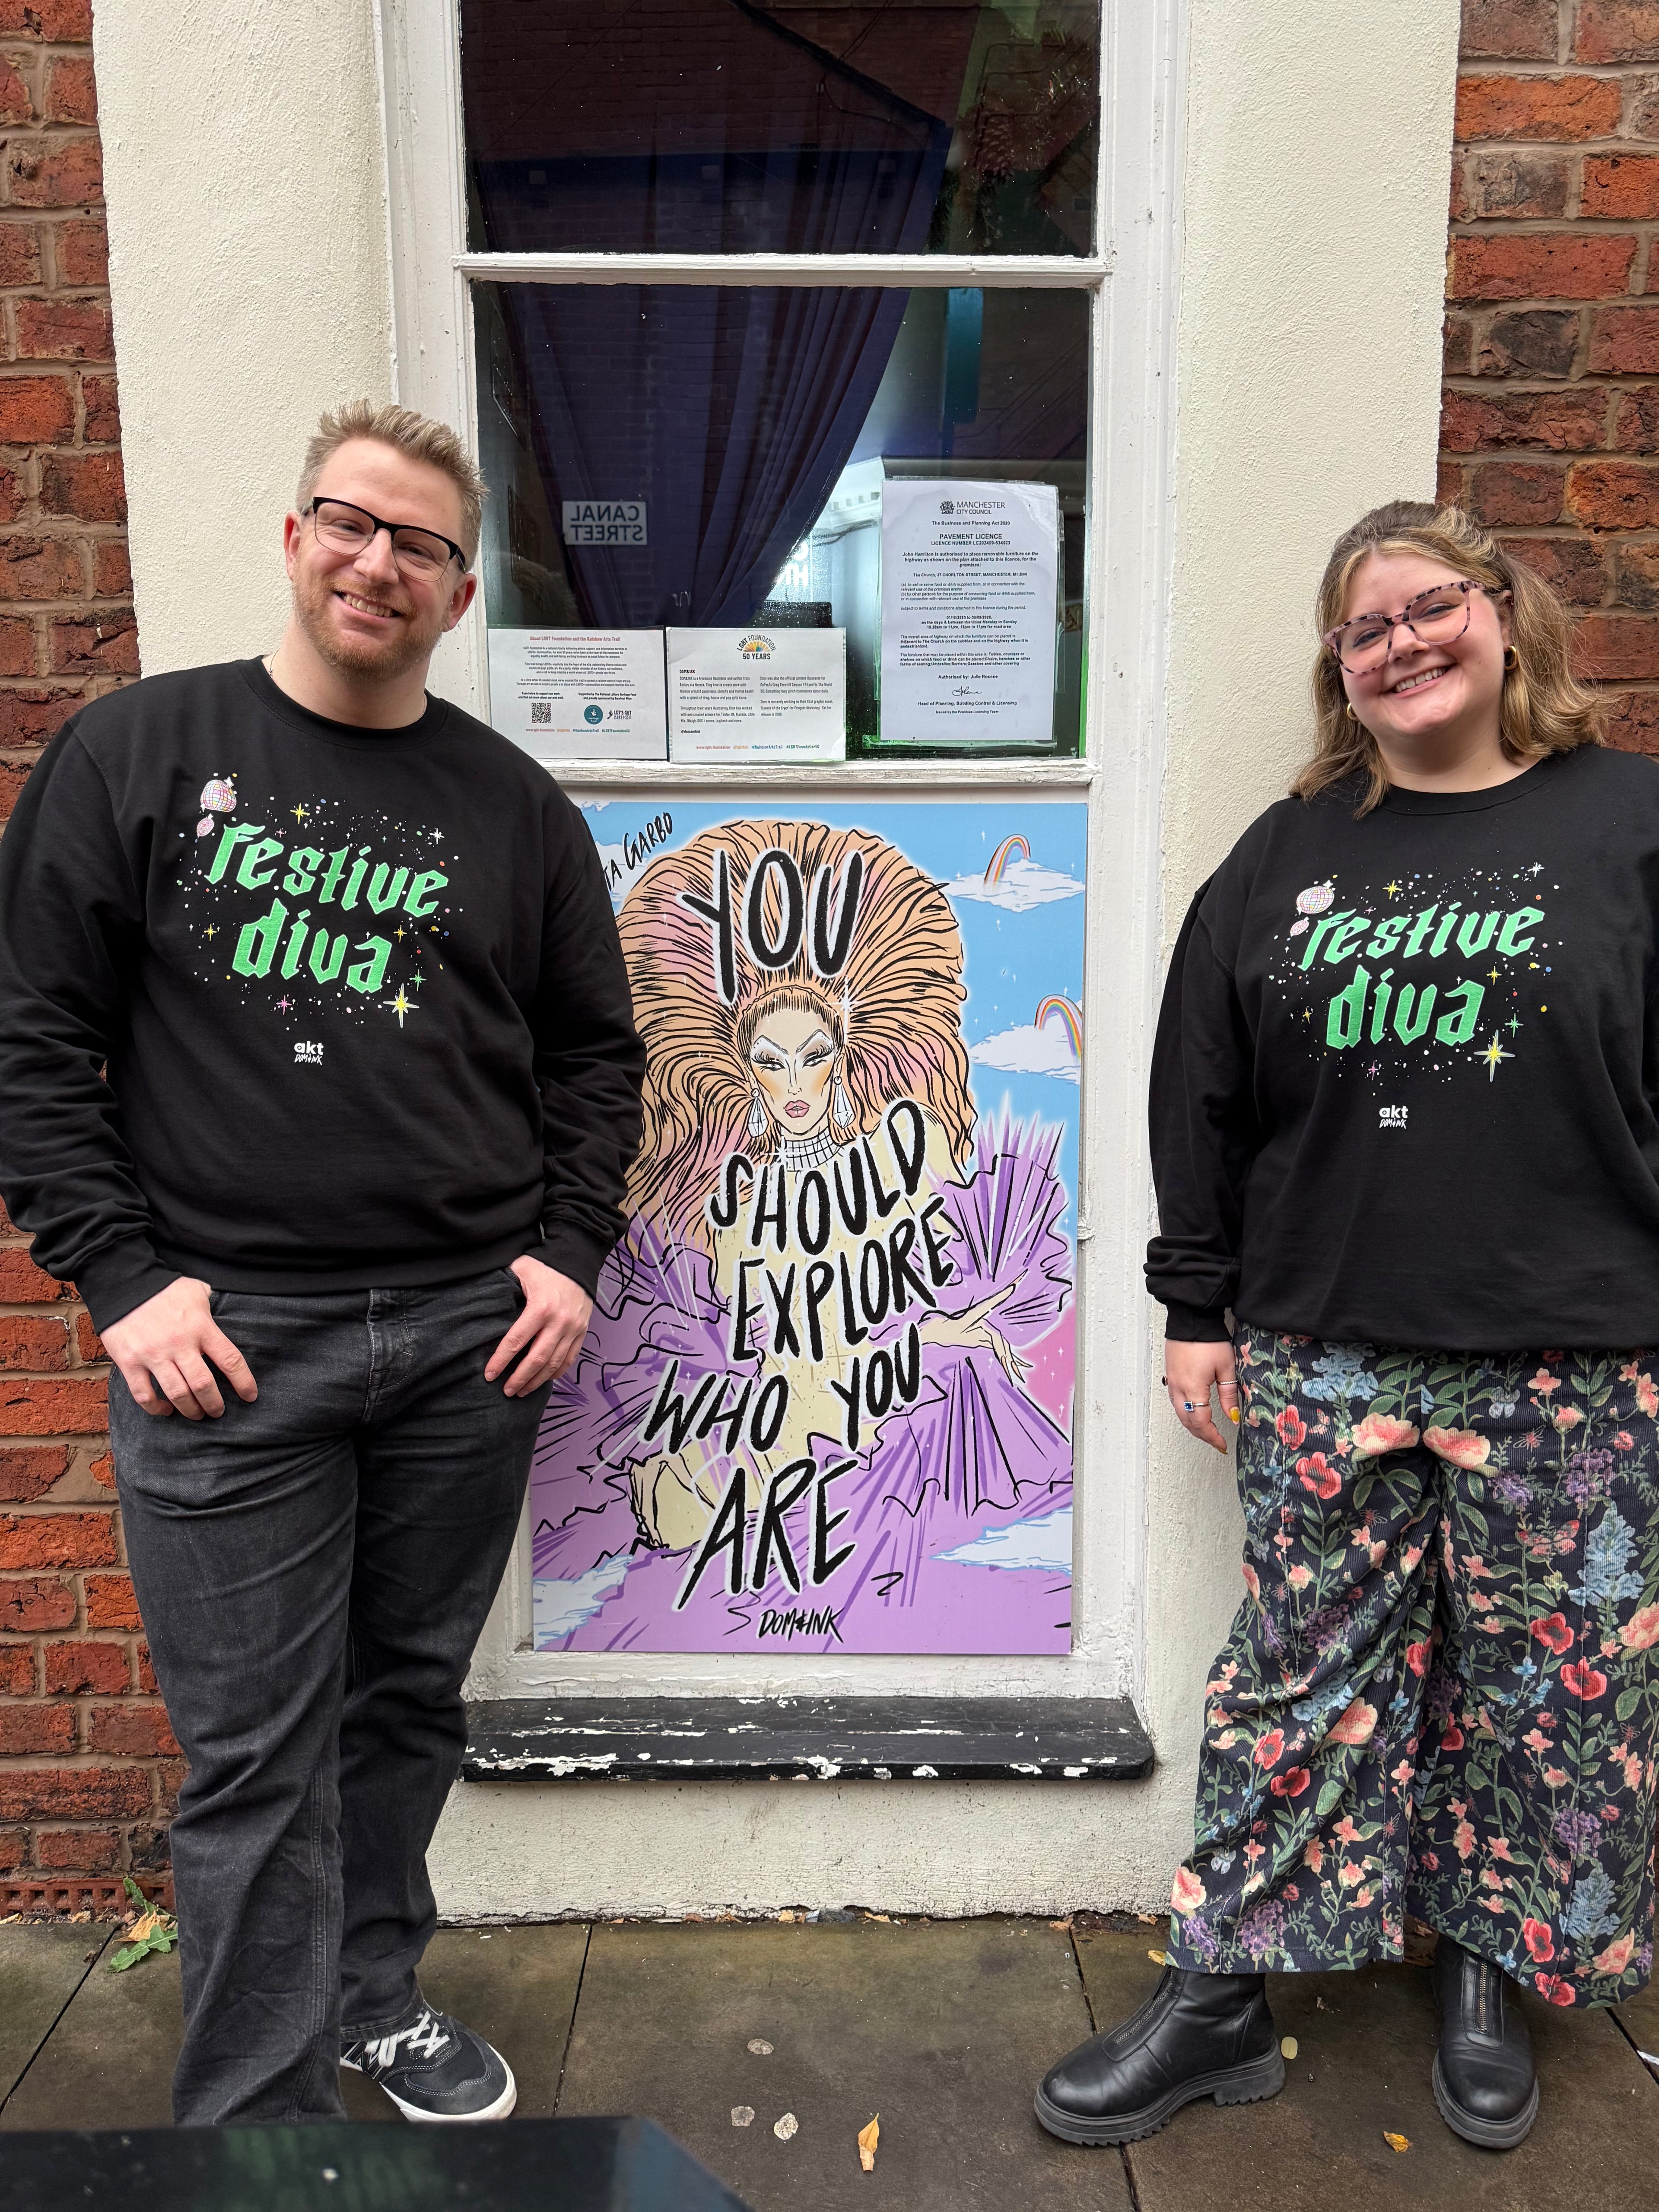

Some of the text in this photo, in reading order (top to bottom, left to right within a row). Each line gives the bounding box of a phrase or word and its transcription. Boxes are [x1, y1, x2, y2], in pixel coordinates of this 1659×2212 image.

[737, 634, 776, 651] LGBT FOUNDATION
[624, 812, 672, 870] GARBO
[232, 898, 392, 993] diva
[680, 848, 864, 1005] YOU
[294, 1041, 324, 1055] akt
[1326, 965, 1485, 1049] diva
[1379, 1105, 1408, 1119] akt
[710, 1100, 925, 1253] SHOULD
[733, 1197, 954, 1361] EXPLORE
[644, 1324, 921, 1455] WHO YOU
[677, 1460, 858, 1609] ARE
[758, 1605, 845, 1643] DOM&INK
